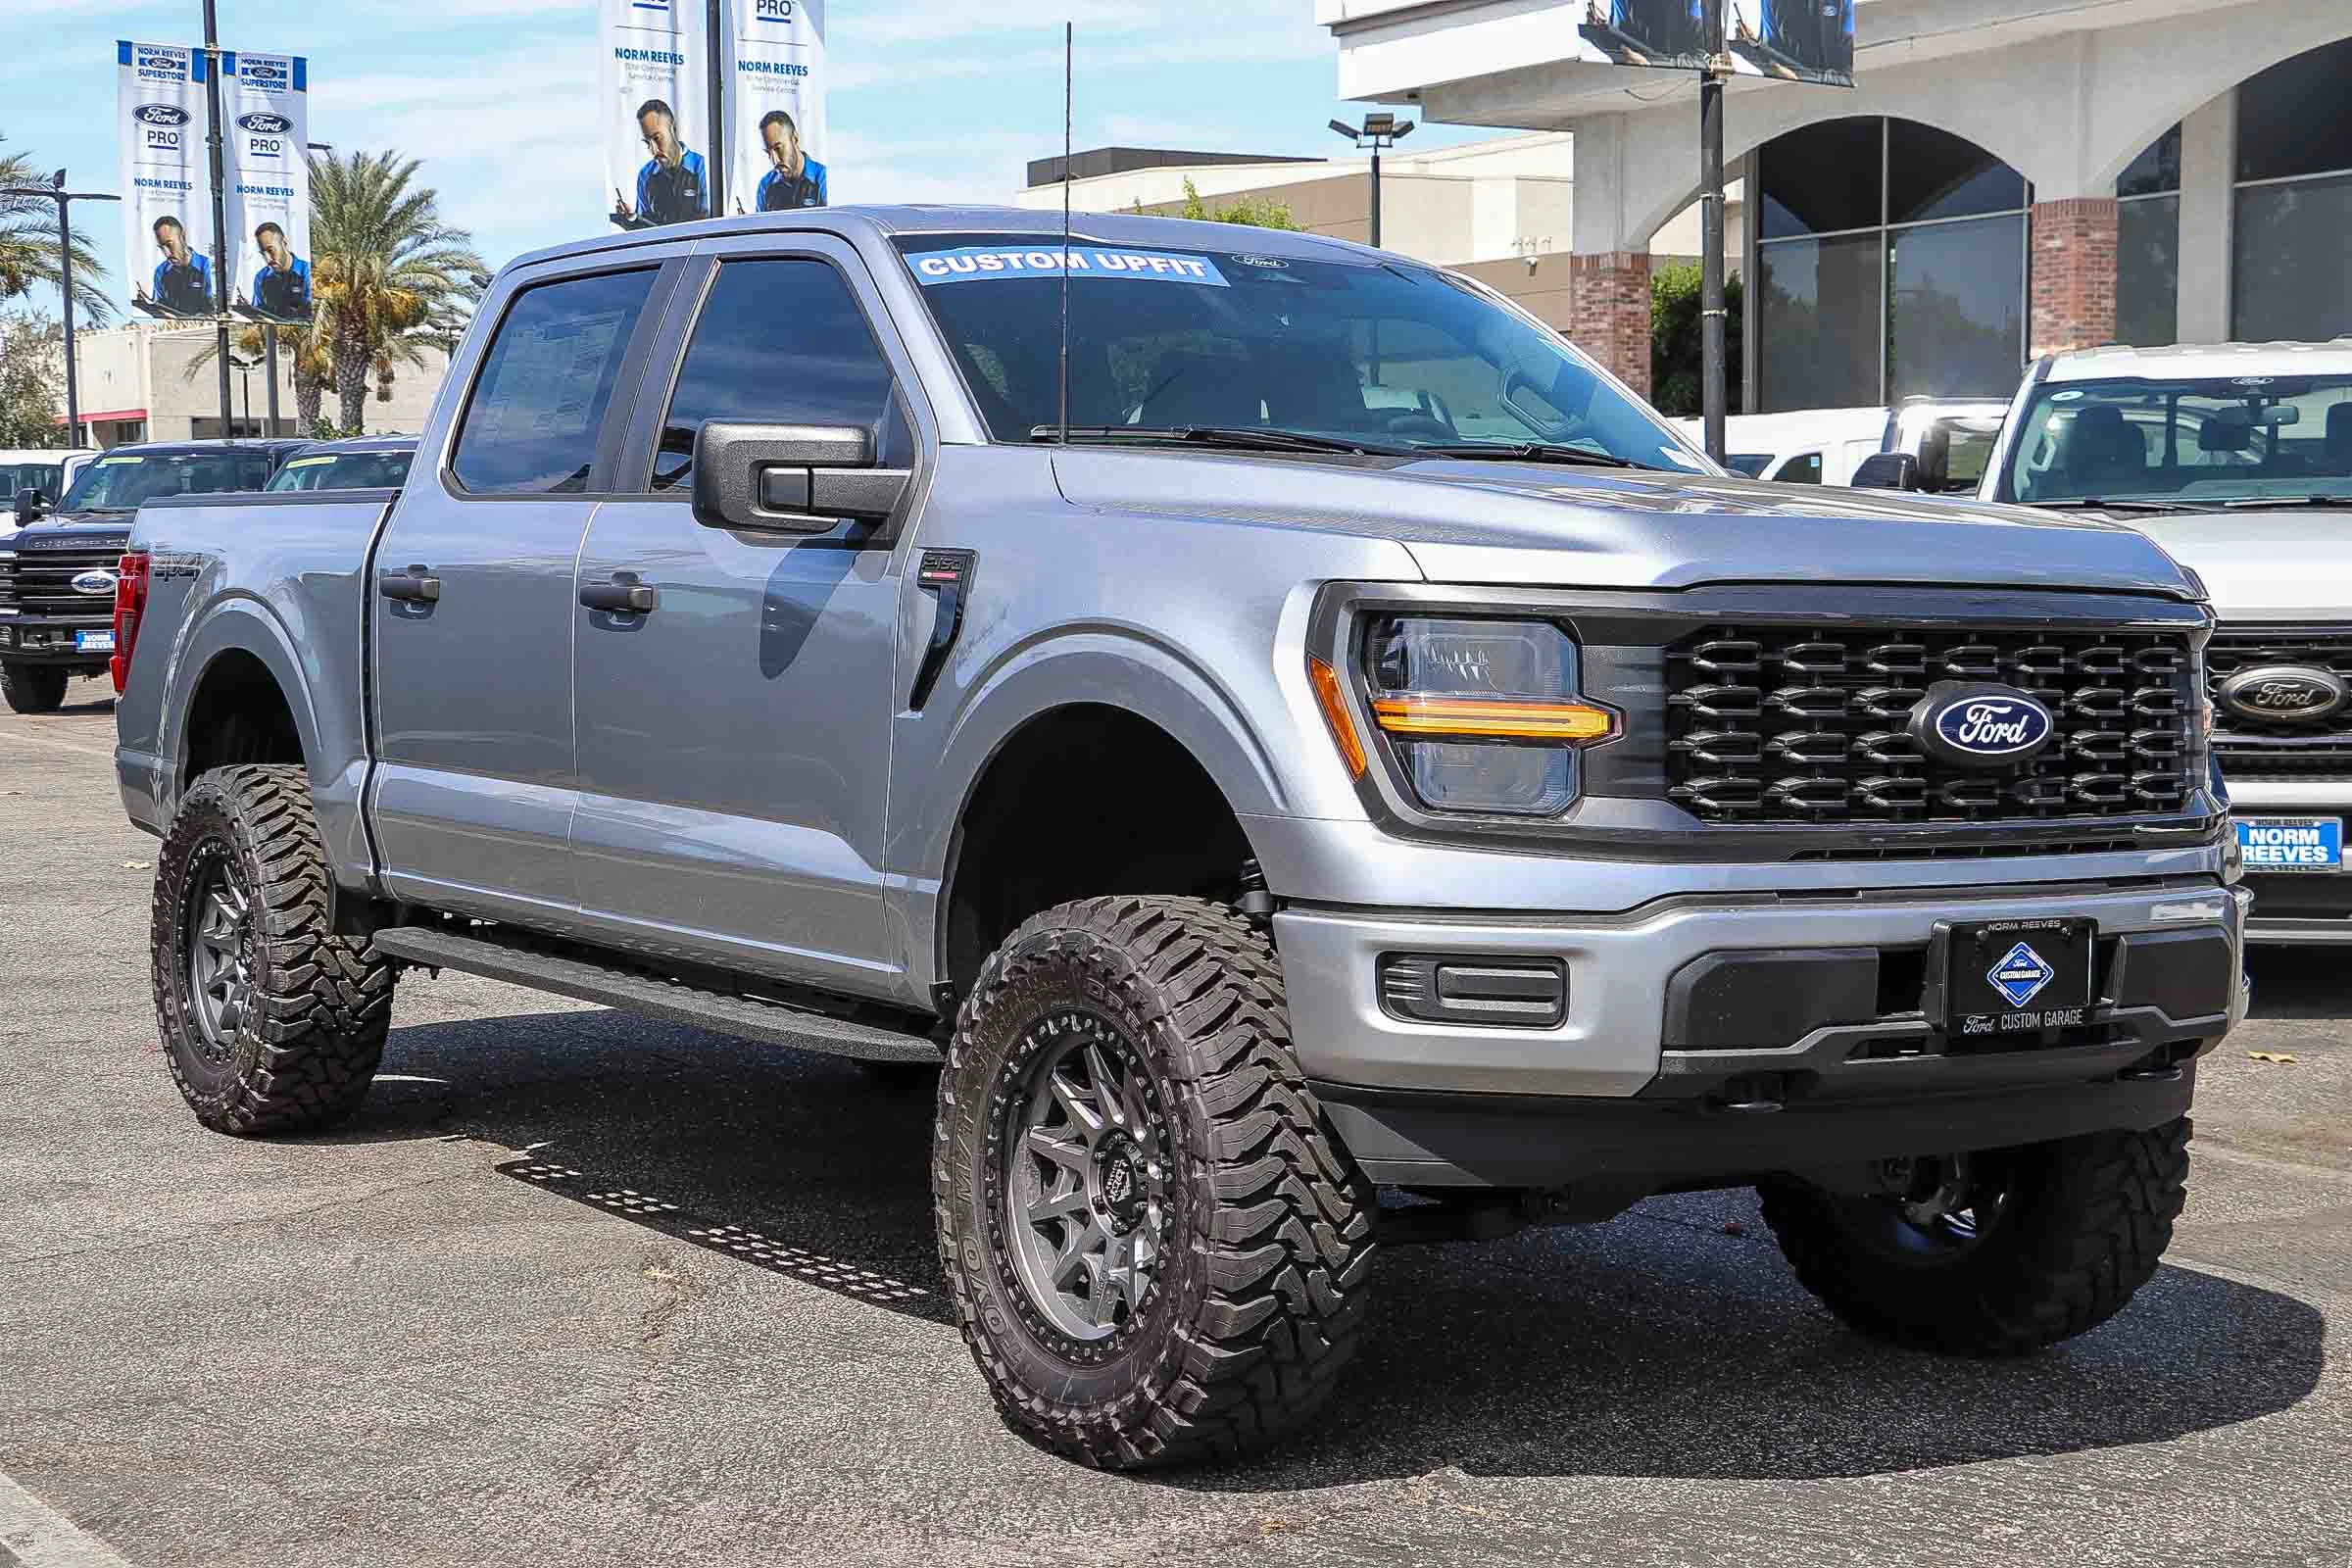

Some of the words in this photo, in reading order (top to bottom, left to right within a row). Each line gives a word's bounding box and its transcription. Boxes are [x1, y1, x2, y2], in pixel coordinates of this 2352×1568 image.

[138, 47, 160, 56] NORM
[614, 47, 649, 62] NORM
[650, 50, 684, 66] REEVES
[137, 69, 186, 80] SUPERSTORE
[738, 60, 772, 74] NORM
[773, 62, 808, 76] REEVES
[144, 106, 180, 126] Ford
[247, 115, 282, 132] Ford
[147, 129, 179, 145] PRO
[250, 138, 281, 153] PRO
[133, 177, 162, 189] NORM
[163, 180, 193, 191] REEVES
[235, 185, 264, 195] NORM
[266, 186, 295, 197] REEVES
[918, 251, 1091, 276] CUSTOM
[1095, 252, 1208, 278] UPFIT
[2256, 682, 2315, 707] Ford
[1959, 704, 2030, 744] Ford
[2248, 828, 2320, 846] NORM
[2241, 845, 2329, 862] REEVES
[1987, 922, 2020, 932] NORM
[2021, 919, 2061, 929] REEVES
[1999, 970, 2021, 980] CUSTOM
[2021, 969, 2041, 979] GARAGE
[1963, 1014, 1995, 1034] Ford
[2001, 1012, 2040, 1030] CUSTOM
[2044, 1008, 2082, 1027] GARAGE
